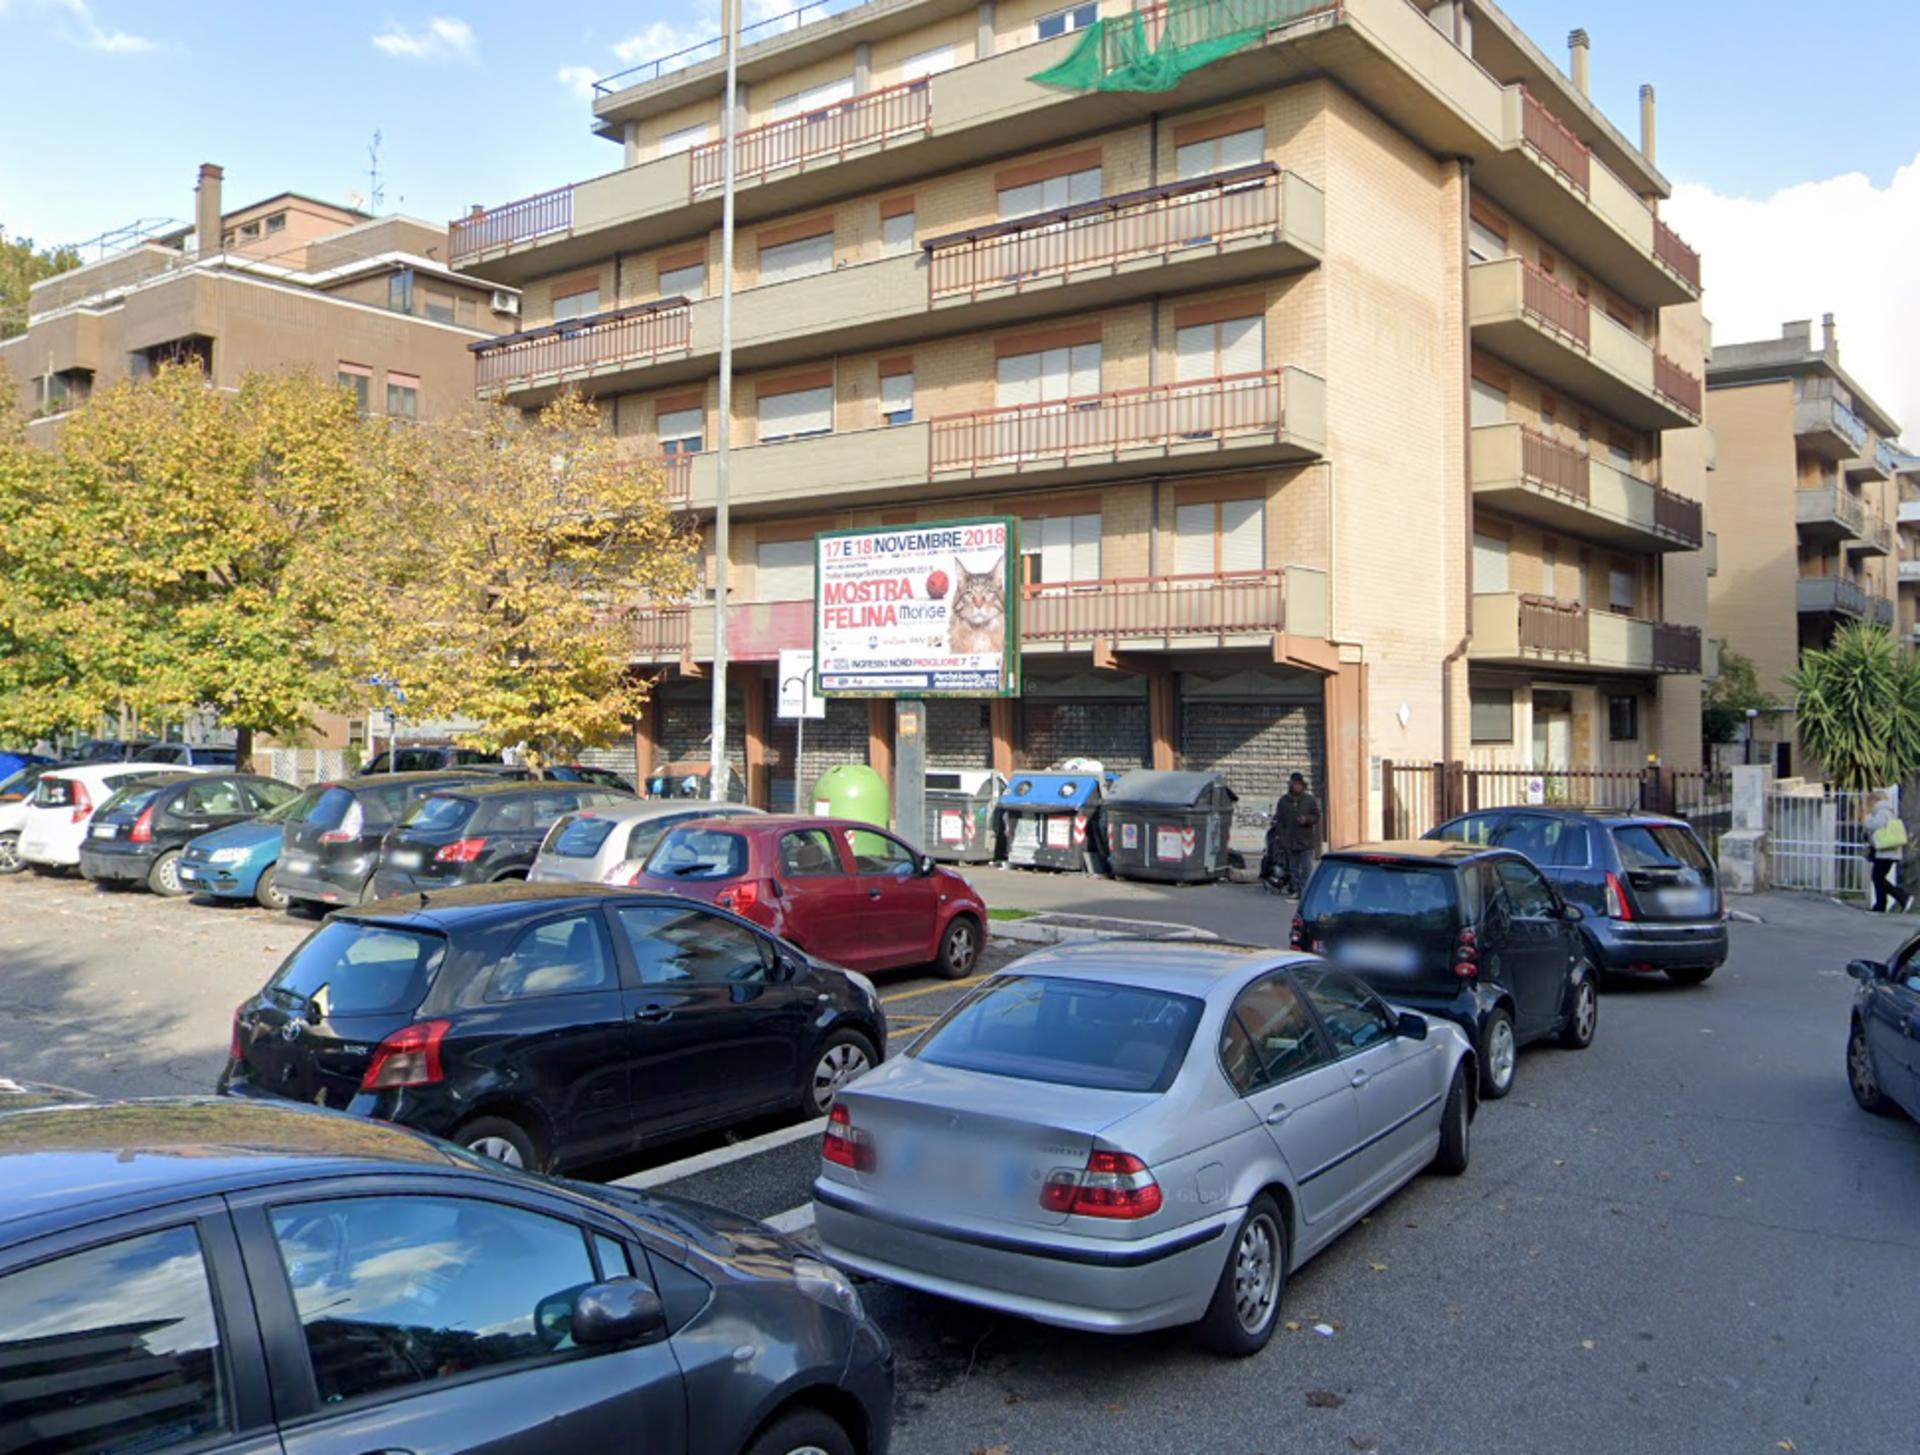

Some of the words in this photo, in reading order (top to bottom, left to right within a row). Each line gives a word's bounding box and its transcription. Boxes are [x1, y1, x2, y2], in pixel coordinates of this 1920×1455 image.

[824, 541, 842, 557] 17
[843, 541, 851, 556] E
[856, 538, 873, 555] 18
[874, 531, 962, 553] NOVEMBRE
[964, 527, 1006, 547] 2018
[824, 577, 913, 606] MOSTRA
[824, 604, 898, 630] FELINA
[889, 658, 912, 668] NORD
